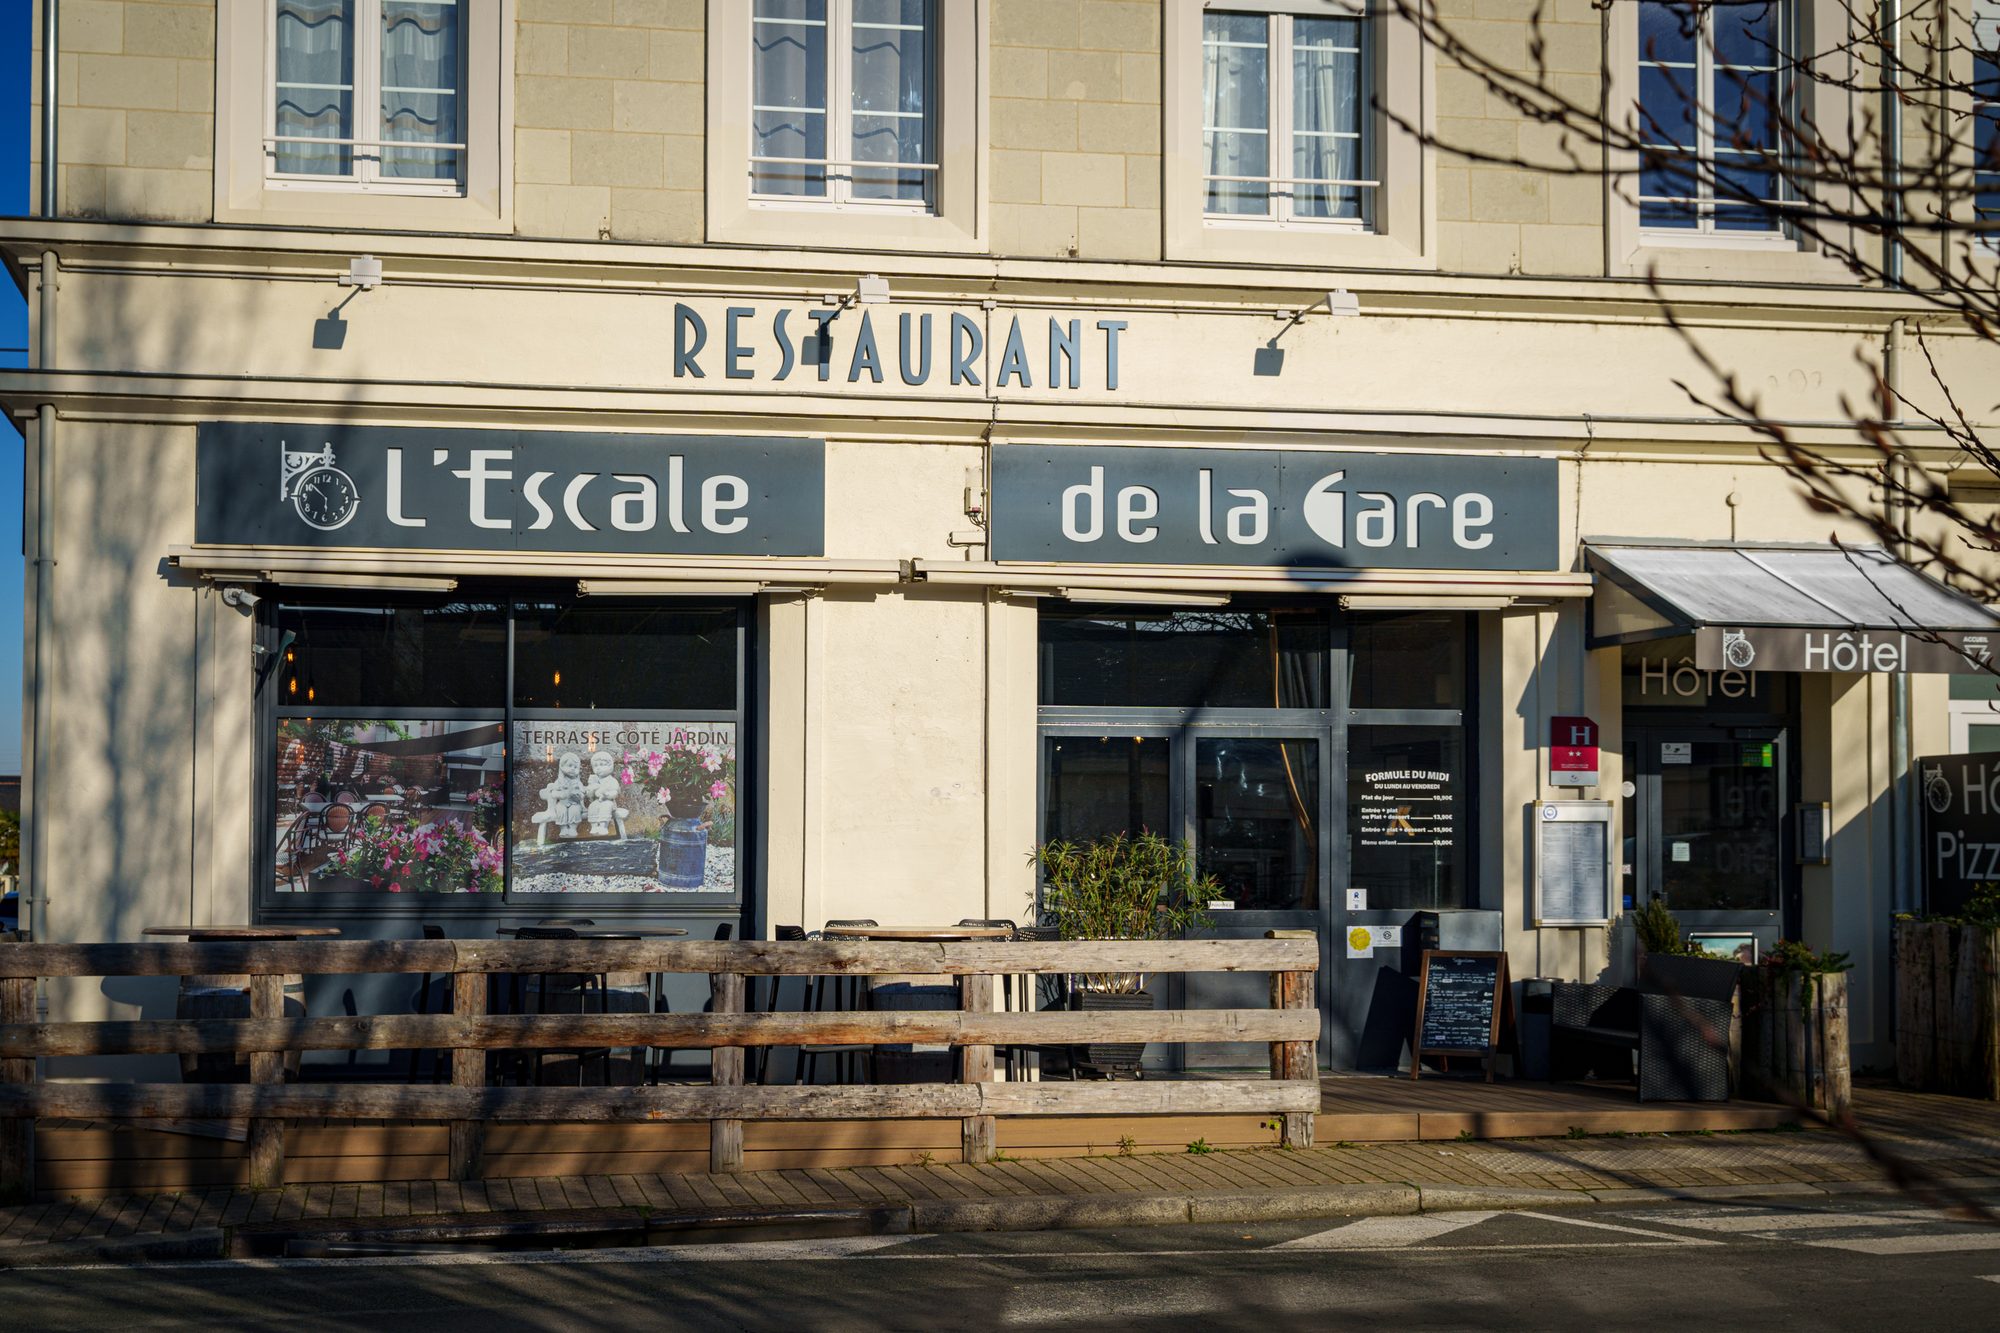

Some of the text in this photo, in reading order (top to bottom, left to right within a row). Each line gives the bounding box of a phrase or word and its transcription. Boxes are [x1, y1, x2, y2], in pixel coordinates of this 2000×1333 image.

[674, 303, 1128, 390] RESTAURANT
[387, 447, 749, 534] L'Escale
[1062, 466, 1494, 550] de la Gare
[1805, 633, 1907, 672] Hôtel
[1641, 656, 1756, 698] Hôtel
[522, 728, 728, 745] TERRASSE CÔTÉ JARDIN
[1570, 726, 1591, 745] H
[1365, 770, 1450, 782] FORMULE DU MIDI
[1937, 829, 2000, 879] Pizz
